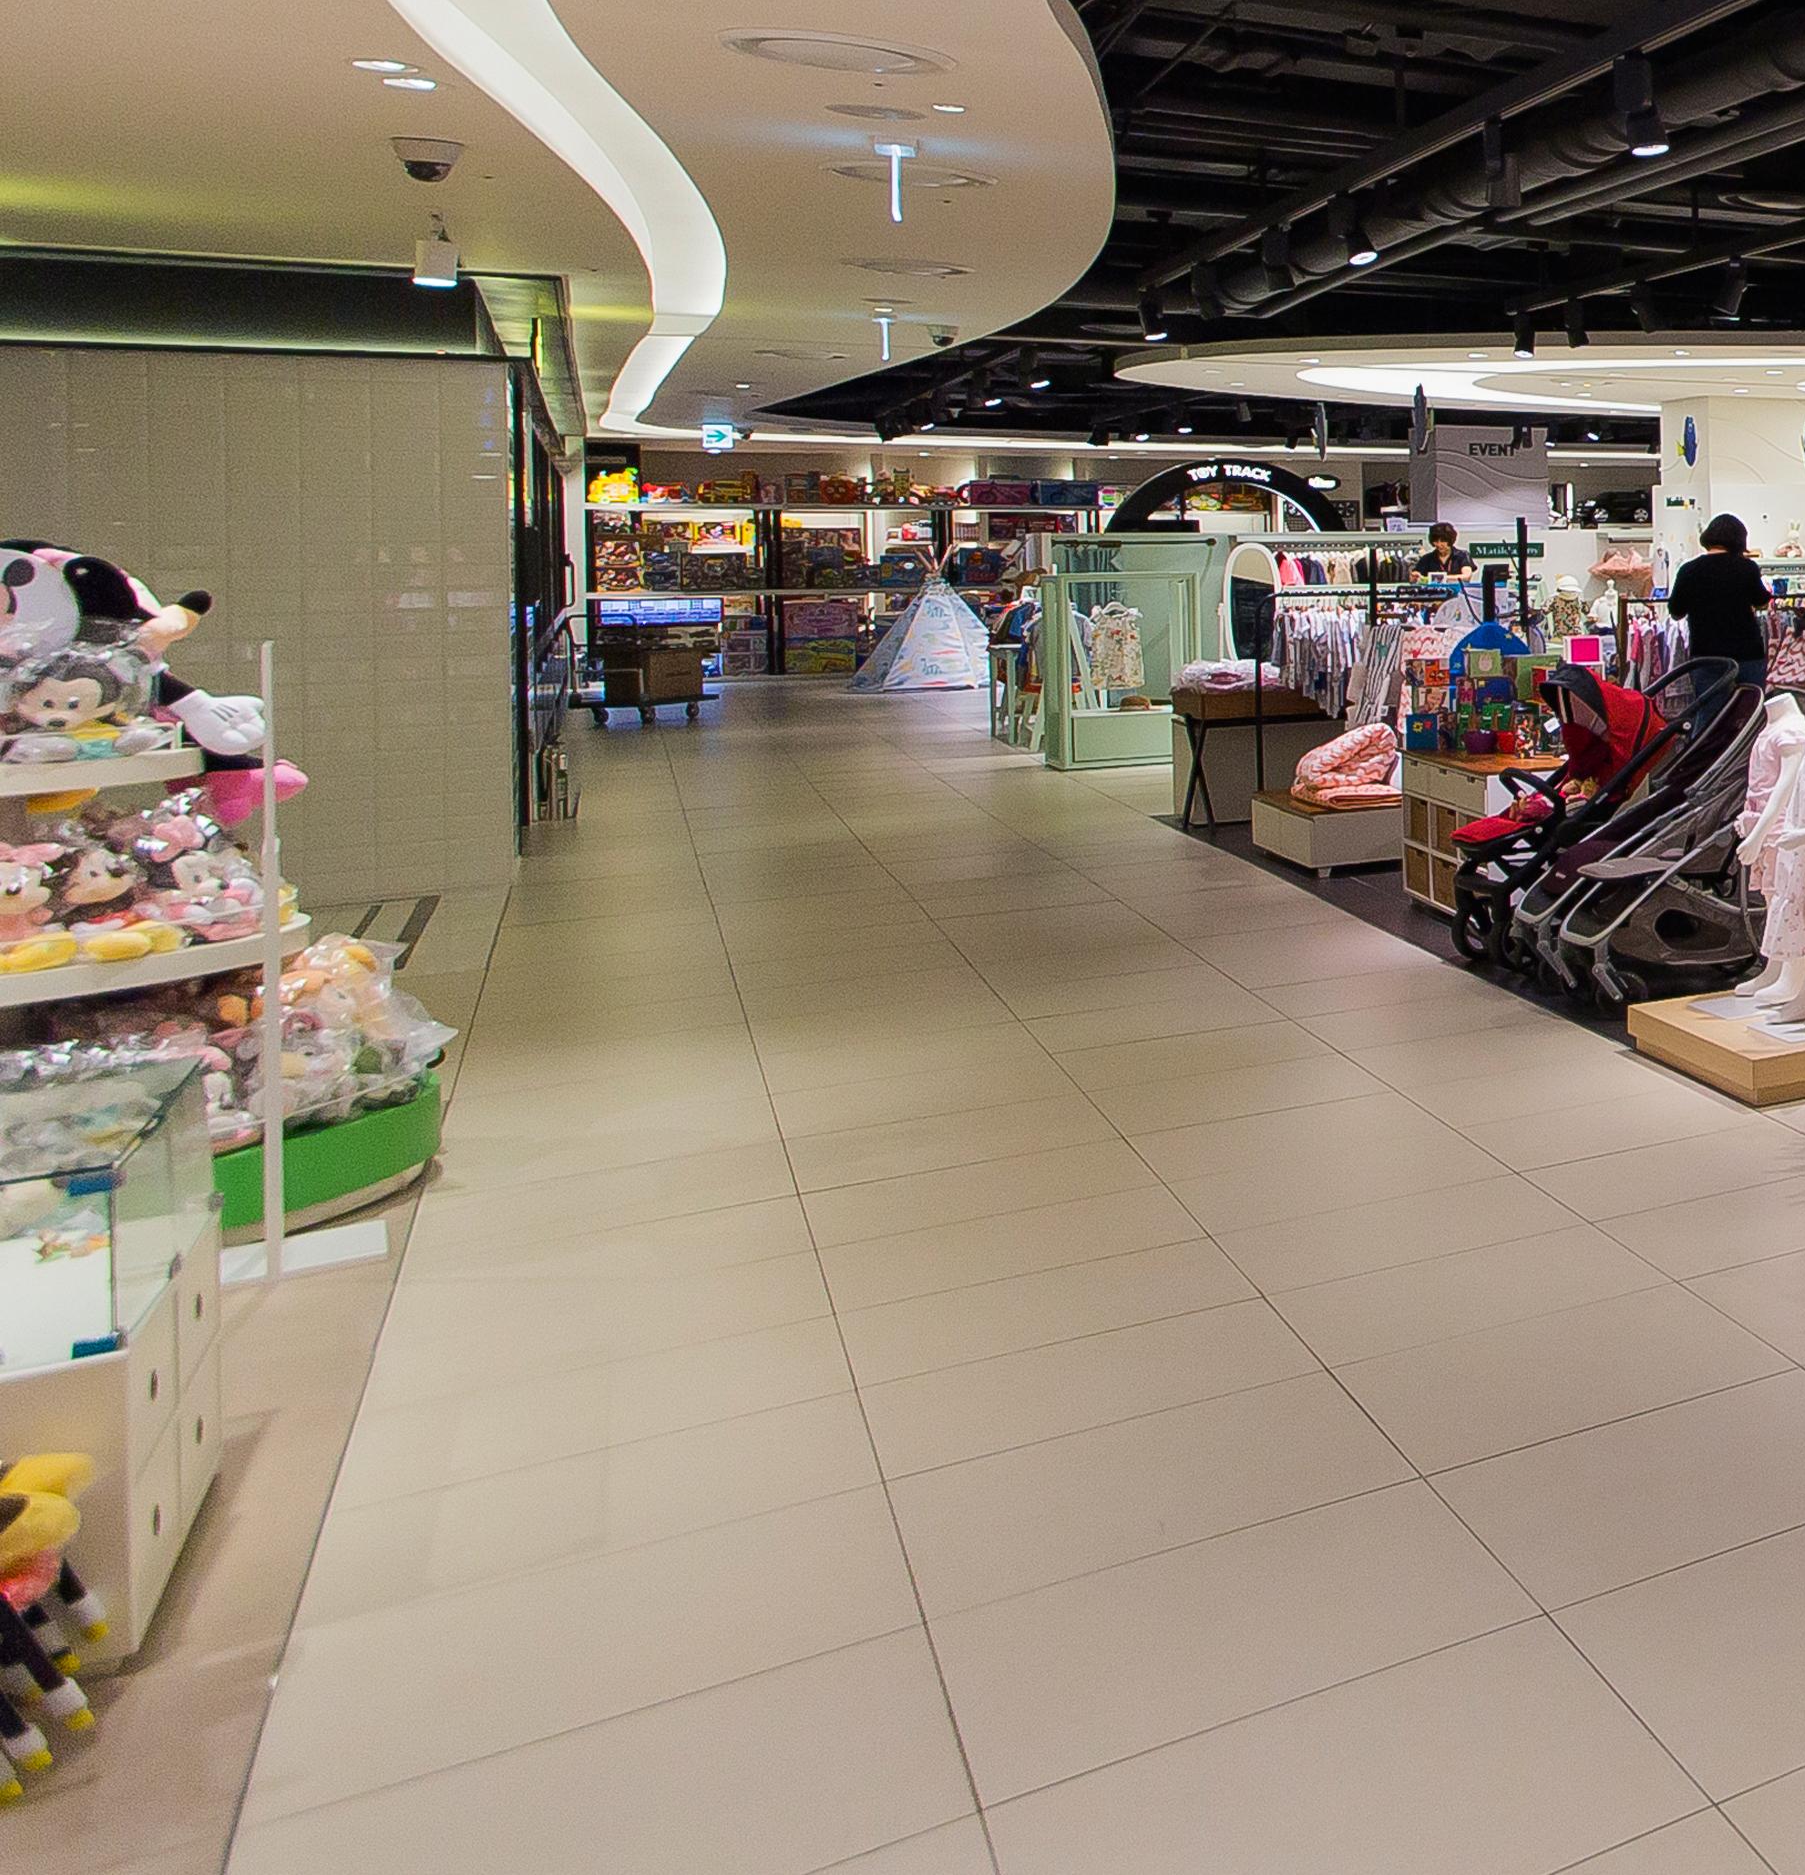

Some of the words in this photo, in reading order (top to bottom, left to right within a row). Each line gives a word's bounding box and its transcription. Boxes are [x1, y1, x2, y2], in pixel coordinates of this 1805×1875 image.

[1469, 443, 1517, 456] EVENT
[1187, 465, 1219, 482] TOY
[1223, 464, 1272, 482] TRACK
